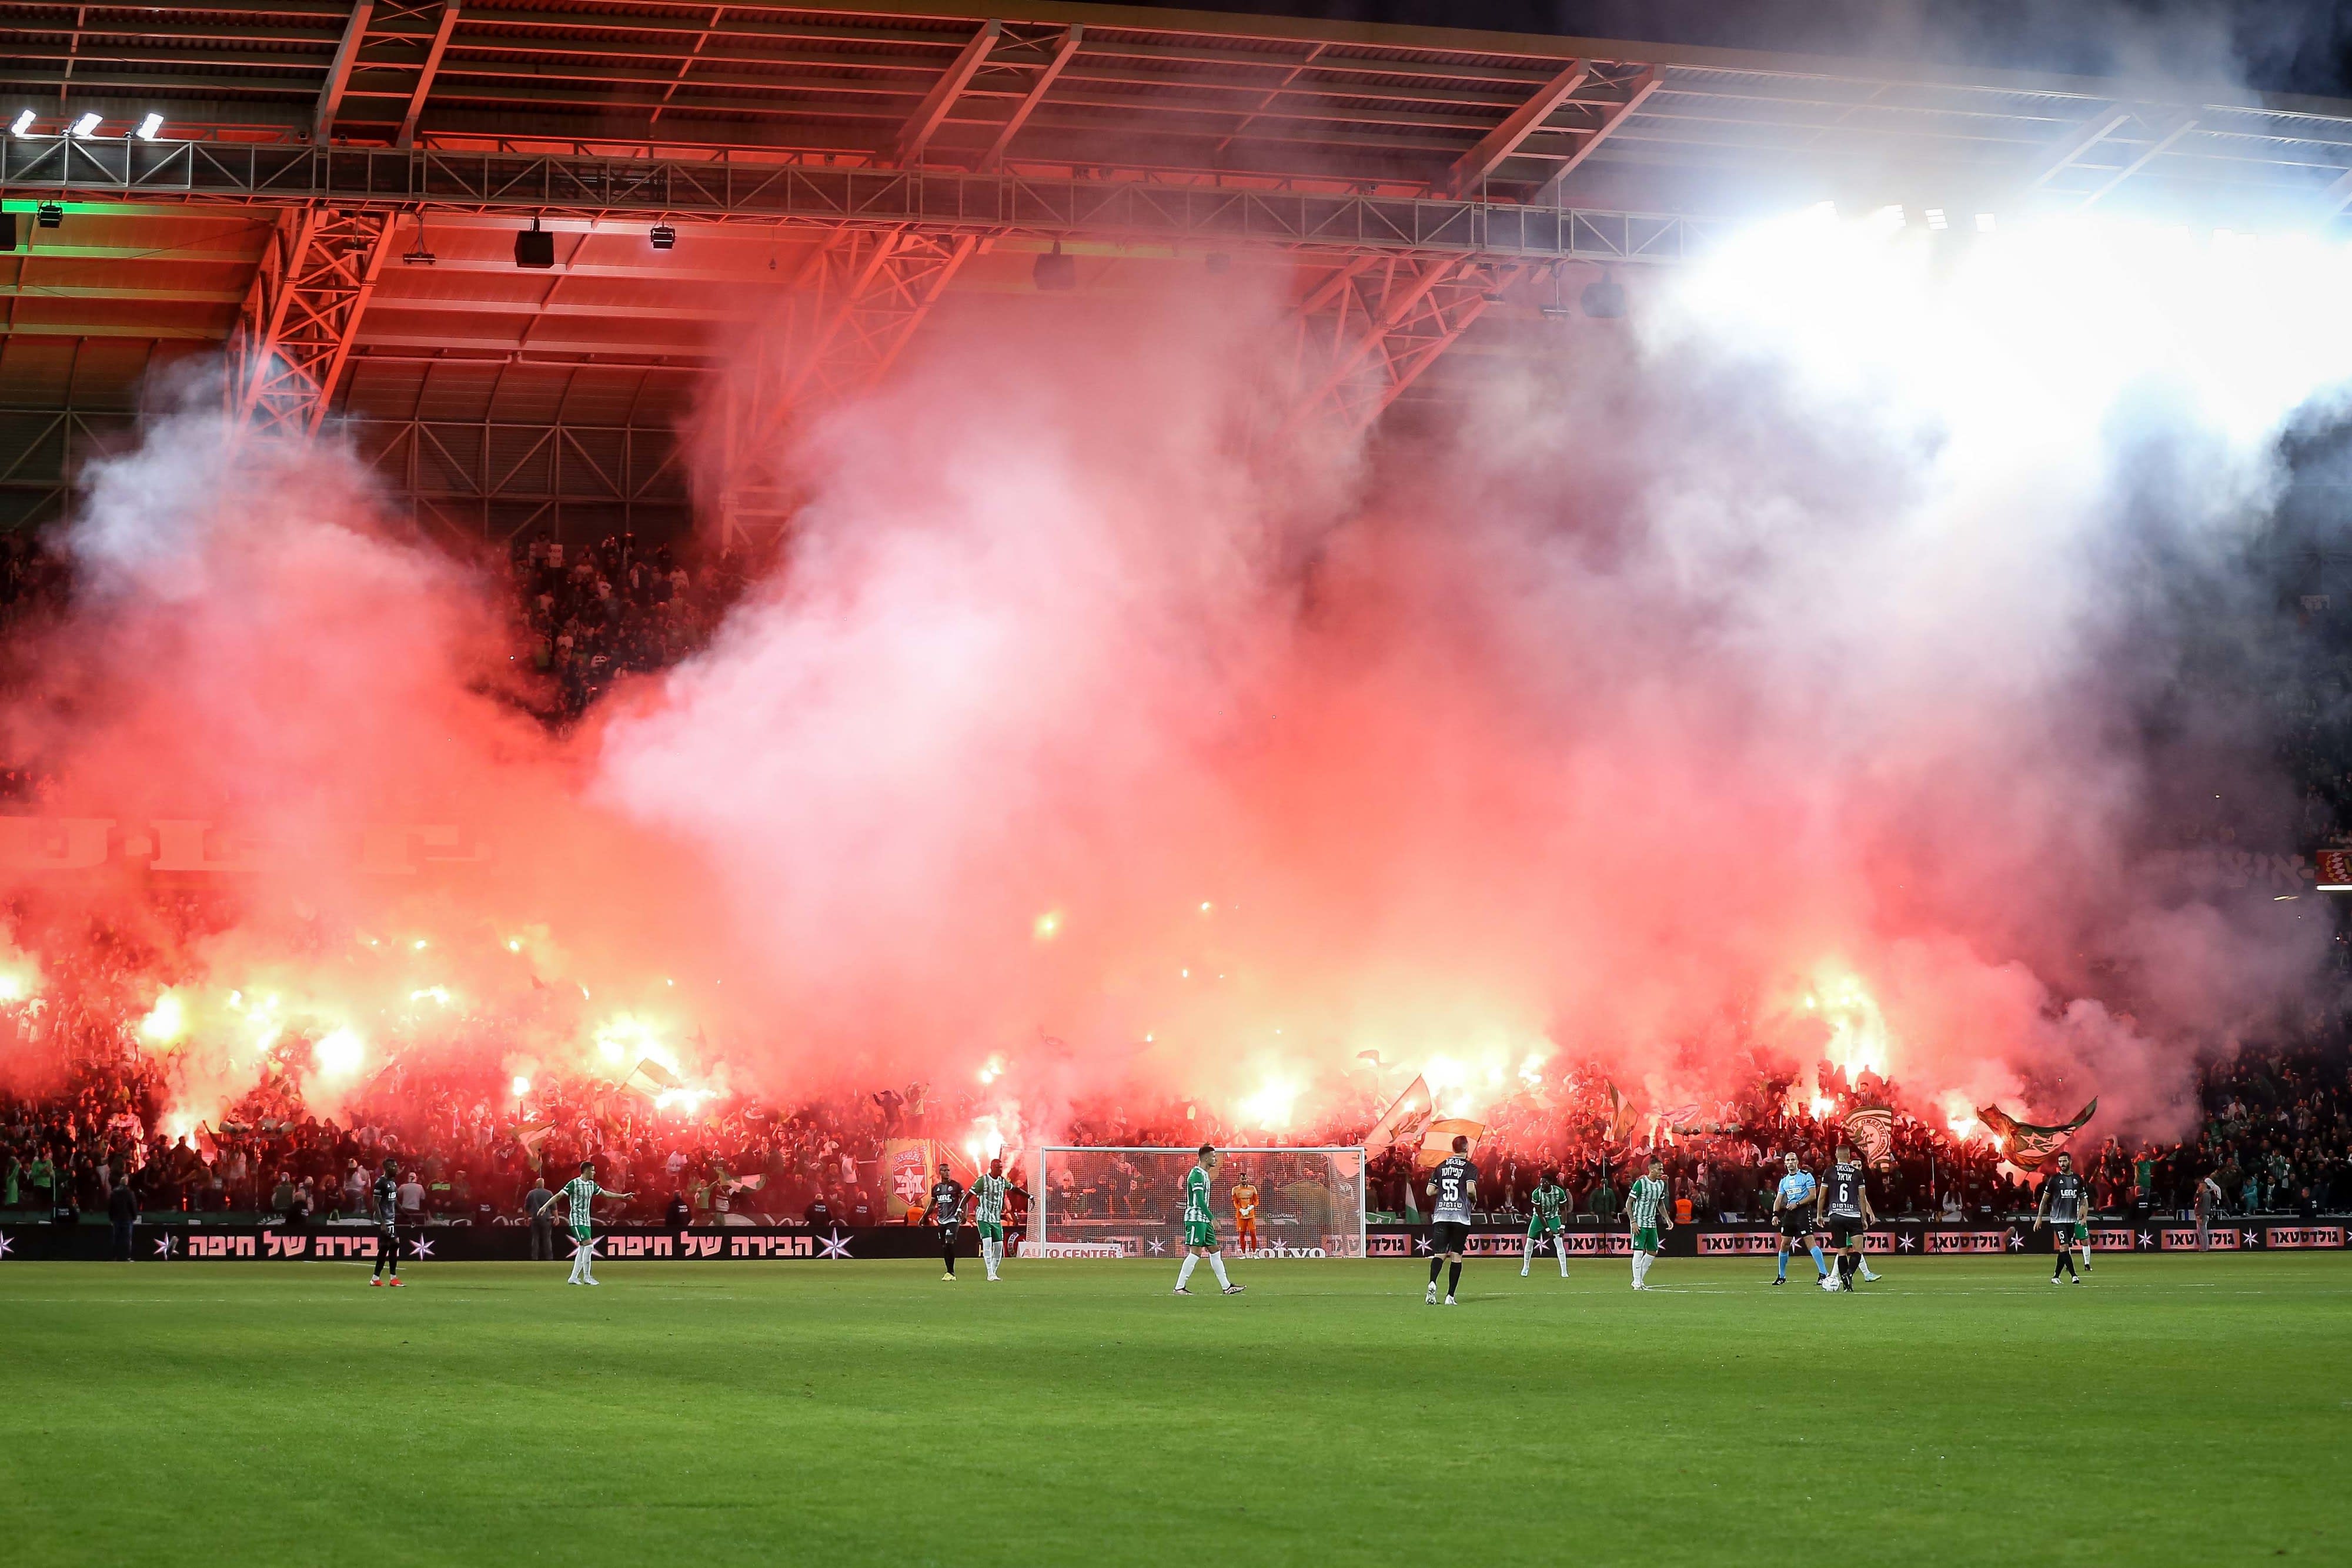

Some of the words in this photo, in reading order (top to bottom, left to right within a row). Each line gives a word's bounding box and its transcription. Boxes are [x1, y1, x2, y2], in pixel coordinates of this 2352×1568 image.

[1837, 1172, 1852, 1182] אראל
[1442, 1178, 1459, 1202] 55
[1839, 1182, 1849, 1203] 6
[263, 1230, 307, 1258] של
[680, 1231, 723, 1258] של
[1563, 1236, 1632, 1251] ולדסטאר
[1702, 1235, 1776, 1250] גולדסטאר
[2057, 1231, 2065, 1240] 15
[2271, 1229, 2339, 1243] גולדסטאר
[189, 1236, 255, 1256] חיפה
[316, 1236, 399, 1256] בירה
[607, 1236, 673, 1256] חיפה
[731, 1236, 813, 1256] הבירה
[1063, 1248, 1117, 1258] CENTER
